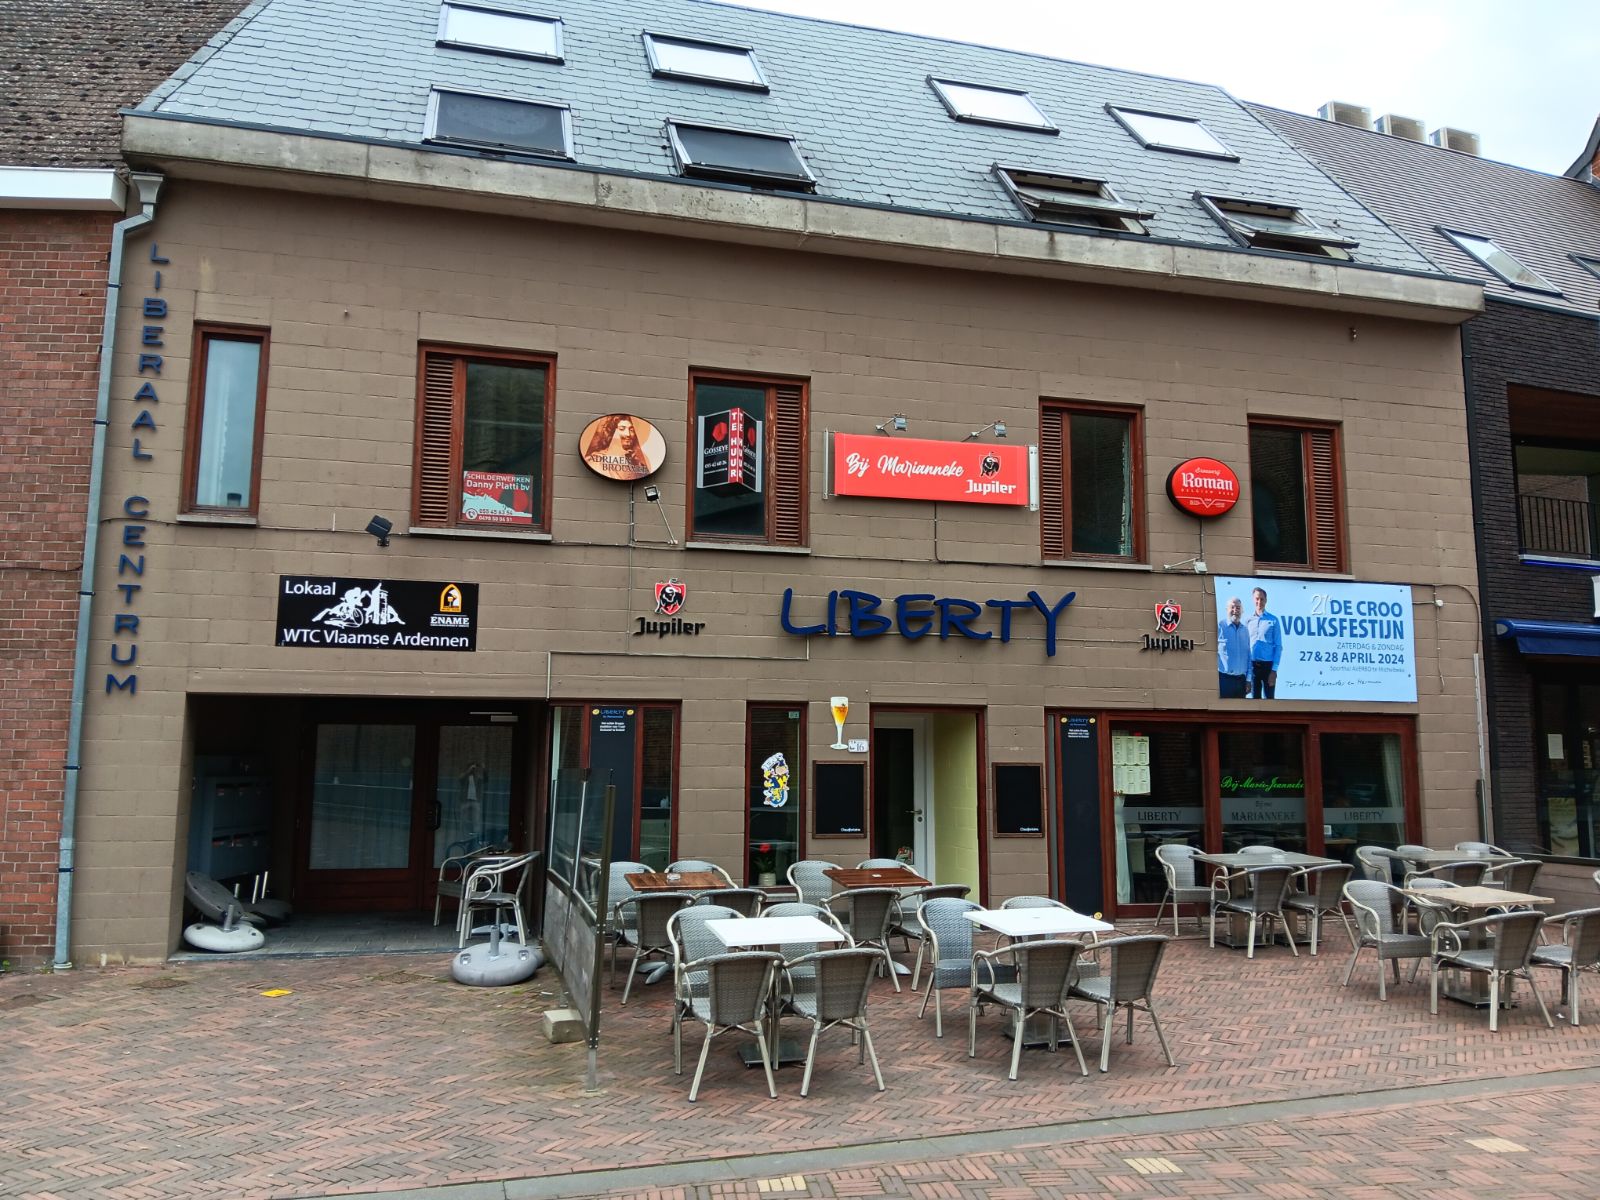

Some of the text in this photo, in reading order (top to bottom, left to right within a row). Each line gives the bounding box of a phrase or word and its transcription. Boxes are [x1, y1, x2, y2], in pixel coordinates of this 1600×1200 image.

[730, 412, 738, 478] TE HUUR
[589, 454, 632, 465] ADRIAEN
[845, 452, 965, 478] Bij Marianneke
[105, 241, 170, 696] LIBERAAL CENTRUM
[466, 473, 531, 483] SCHILDERWERKEN
[466, 480, 494, 490] Danny
[495, 481, 519, 490] Platti
[1181, 472, 1233, 491] Roman
[965, 479, 1017, 496] Jupiler
[284, 580, 337, 596] Lokaal
[1330, 599, 1354, 616] DE
[1356, 600, 1403, 618] CROO
[430, 616, 470, 625] ENAME
[633, 617, 706, 639] Jupiler
[780, 587, 1076, 657] LIBERTY
[1280, 615, 1405, 640] VOLKSFESTIJN
[283, 628, 470, 647] WTC Vlaamse Ardennen
[1337, 642, 1370, 650] ZATERDAG
[1341, 653, 1375, 664] APRIL
[1378, 654, 1405, 664] 2024
[1220, 776, 1239, 792] Bij
[1137, 811, 1182, 821] LIBERTY
[1231, 811, 1297, 821] MARIANNEKE
[1343, 810, 1384, 821] LIBERTY
